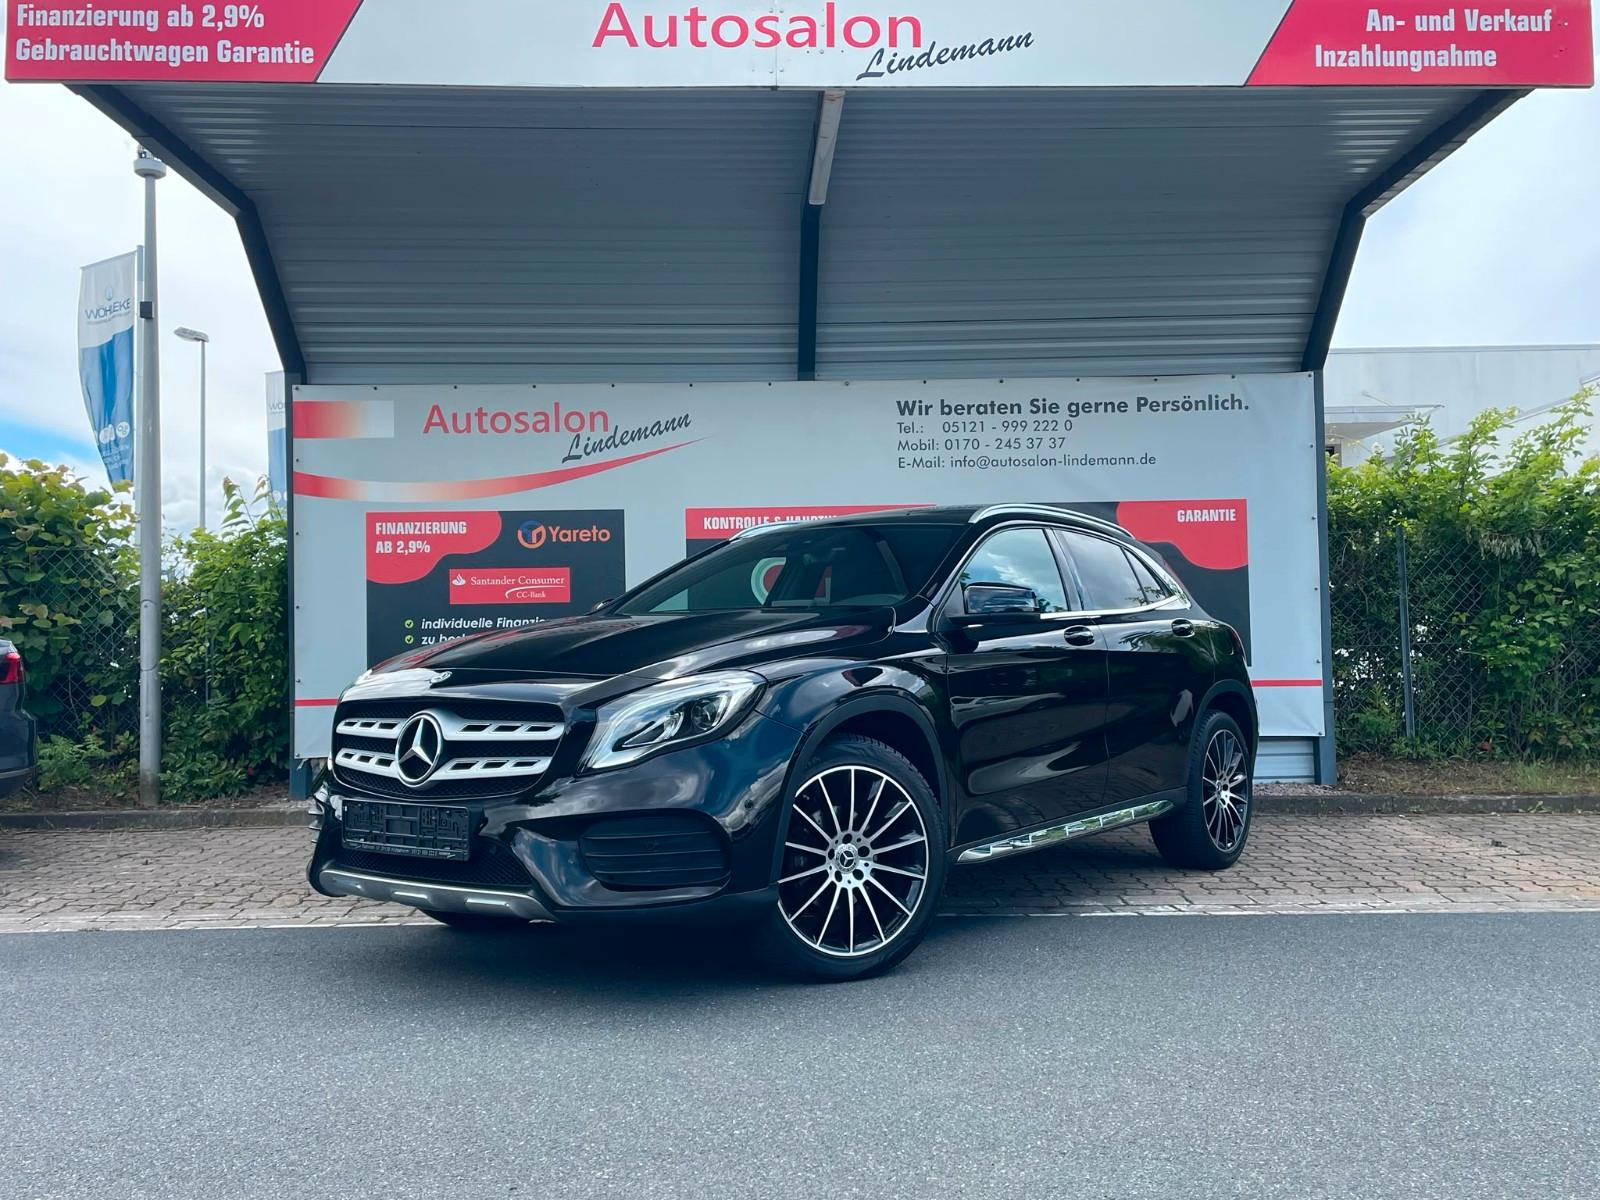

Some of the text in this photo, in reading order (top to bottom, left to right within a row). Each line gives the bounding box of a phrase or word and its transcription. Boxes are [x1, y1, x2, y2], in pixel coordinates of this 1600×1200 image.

[17, 4, 264, 31] Finanzierung ab 2,9%
[592, 2, 922, 49] Autosalon
[1366, 8, 1553, 32] An- und Verkauf
[15, 38, 315, 67] Gebrauchtwagen Garantie
[856, 31, 1035, 81] Lindemann
[1315, 44, 1497, 72] Inzahlungnahme
[896, 393, 1249, 418] Wir beraten Sie gerne Persönlich.
[422, 402, 609, 434] Autosalon
[897, 421, 925, 434] Tel.:
[942, 420, 985, 433] 05121
[1001, 419, 1028, 433] 999
[1033, 419, 1059, 432] 222
[1064, 419, 1073, 432] 0
[561, 412, 692, 463] Lindemann
[897, 438, 940, 451] Mobil:
[944, 438, 980, 451] 0170
[994, 437, 1021, 450] 245
[1026, 437, 1043, 450] 37
[1048, 437, 1066, 449] 37
[898, 452, 1157, 470] E-Mail: info@autosalon-lindemann.de
[1177, 508, 1237, 522] GARANTIE
[375, 521, 467, 535] FINANZIERUNG
[548, 525, 611, 543] Yareto
[375, 540, 431, 555] AB 2,9%
[470, 574, 565, 586] Santander Consumer
[516, 590, 546, 599] CC-Bank
[421, 618, 493, 630] individuelle
[421, 635, 436, 645] zu
